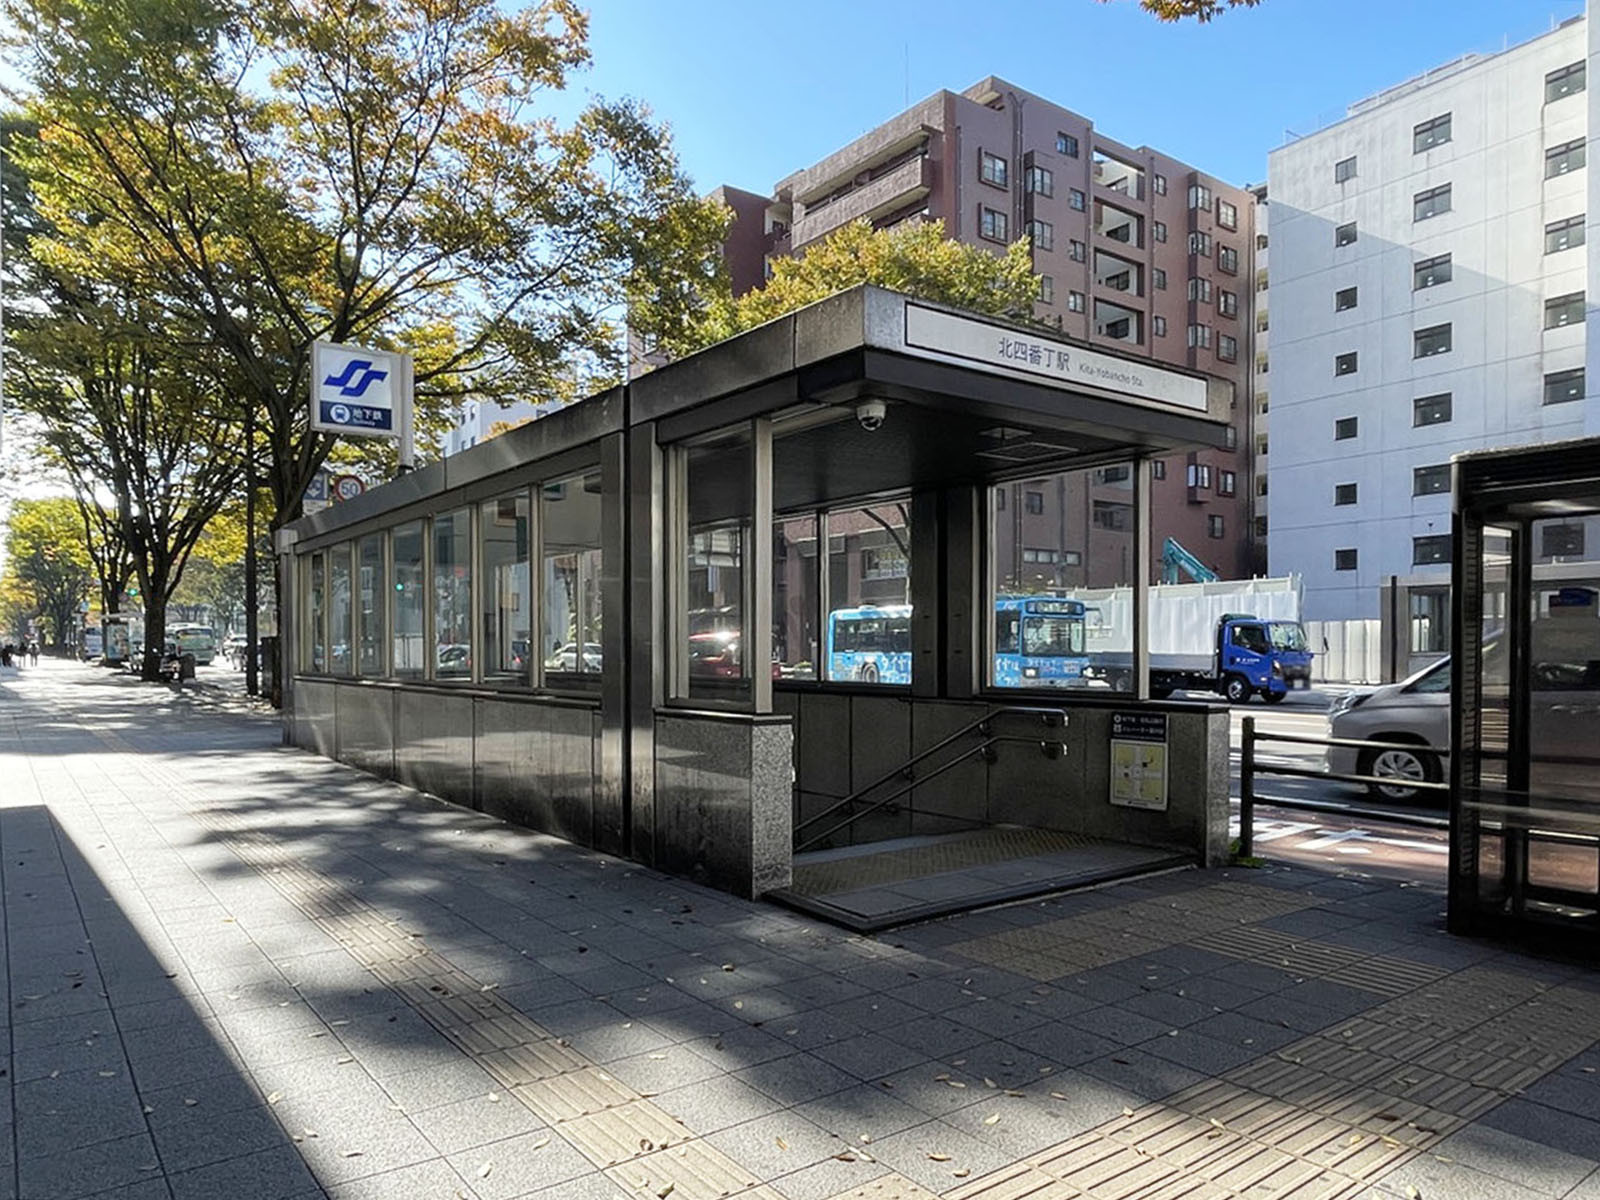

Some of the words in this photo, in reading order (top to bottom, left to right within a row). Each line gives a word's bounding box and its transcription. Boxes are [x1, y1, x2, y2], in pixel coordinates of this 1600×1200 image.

[998, 337, 1070, 372] 北四番丁駅
[351, 406, 383, 421] 地下鉄
[341, 482, 359, 496] 50
